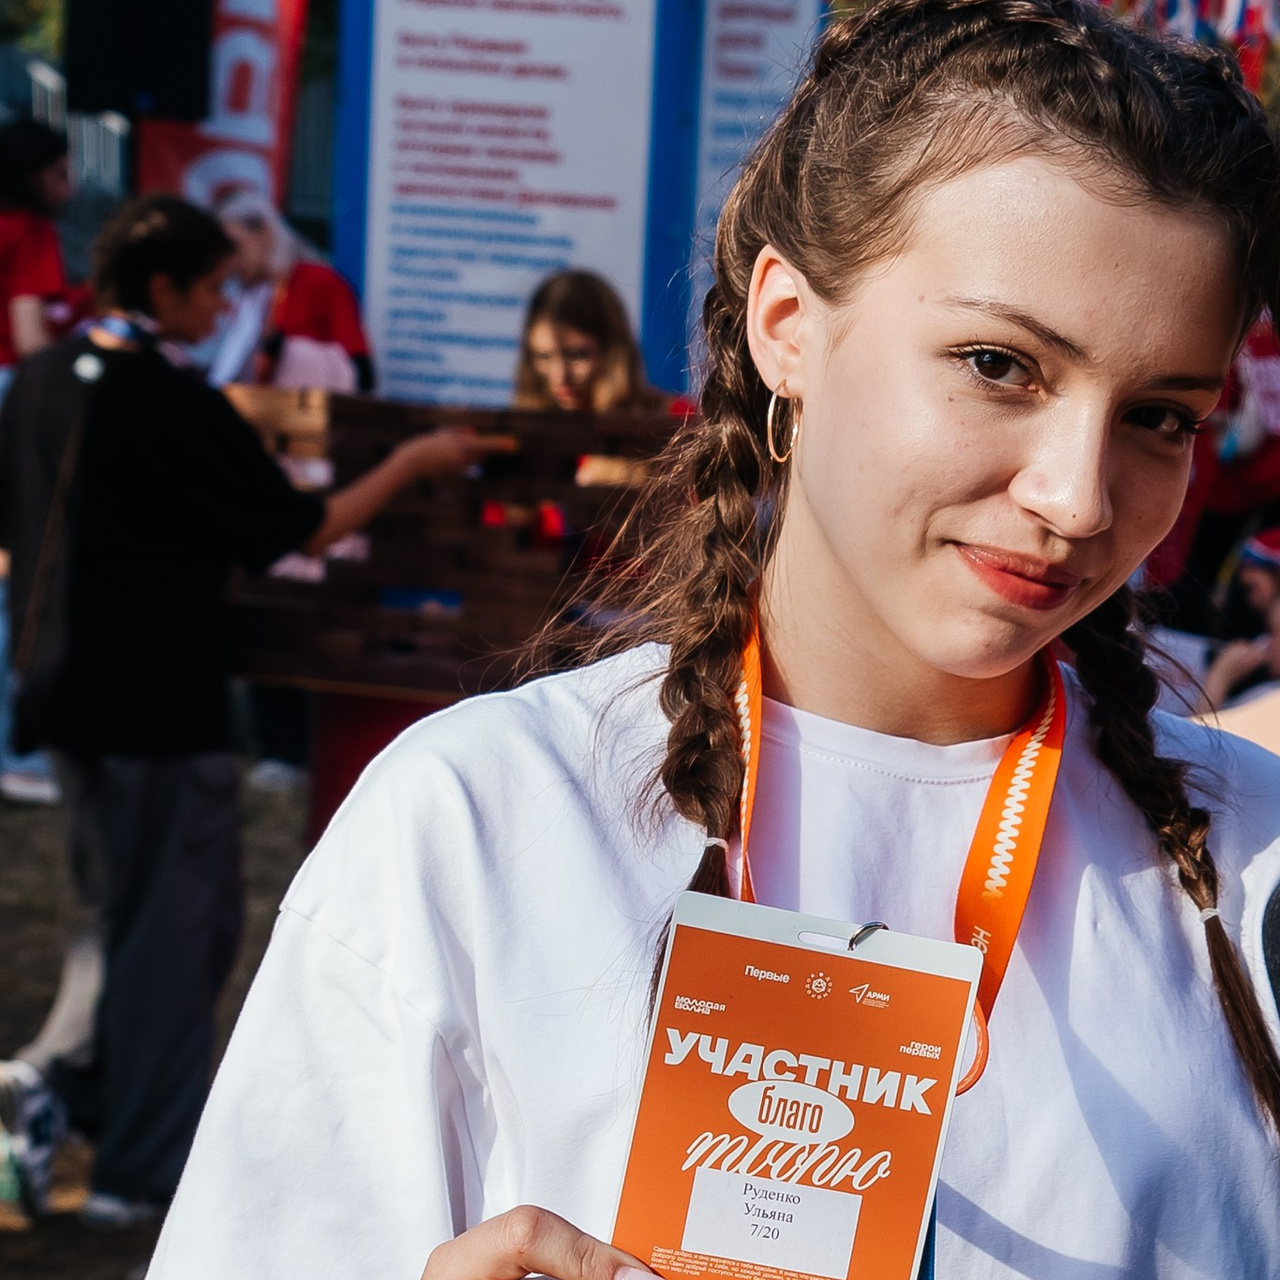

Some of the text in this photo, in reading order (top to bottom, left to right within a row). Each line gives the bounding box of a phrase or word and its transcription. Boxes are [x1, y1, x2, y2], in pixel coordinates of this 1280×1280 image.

[743, 964, 791, 987] Первые
[865, 989, 891, 1002] АРМИ
[663, 1026, 939, 1117] УЧАСТНИК
[757, 1084, 824, 1136] благо
[742, 1182, 802, 1207] Руденко
[743, 1202, 795, 1225] Ульяна
[750, 1223, 781, 1242] 7/20
